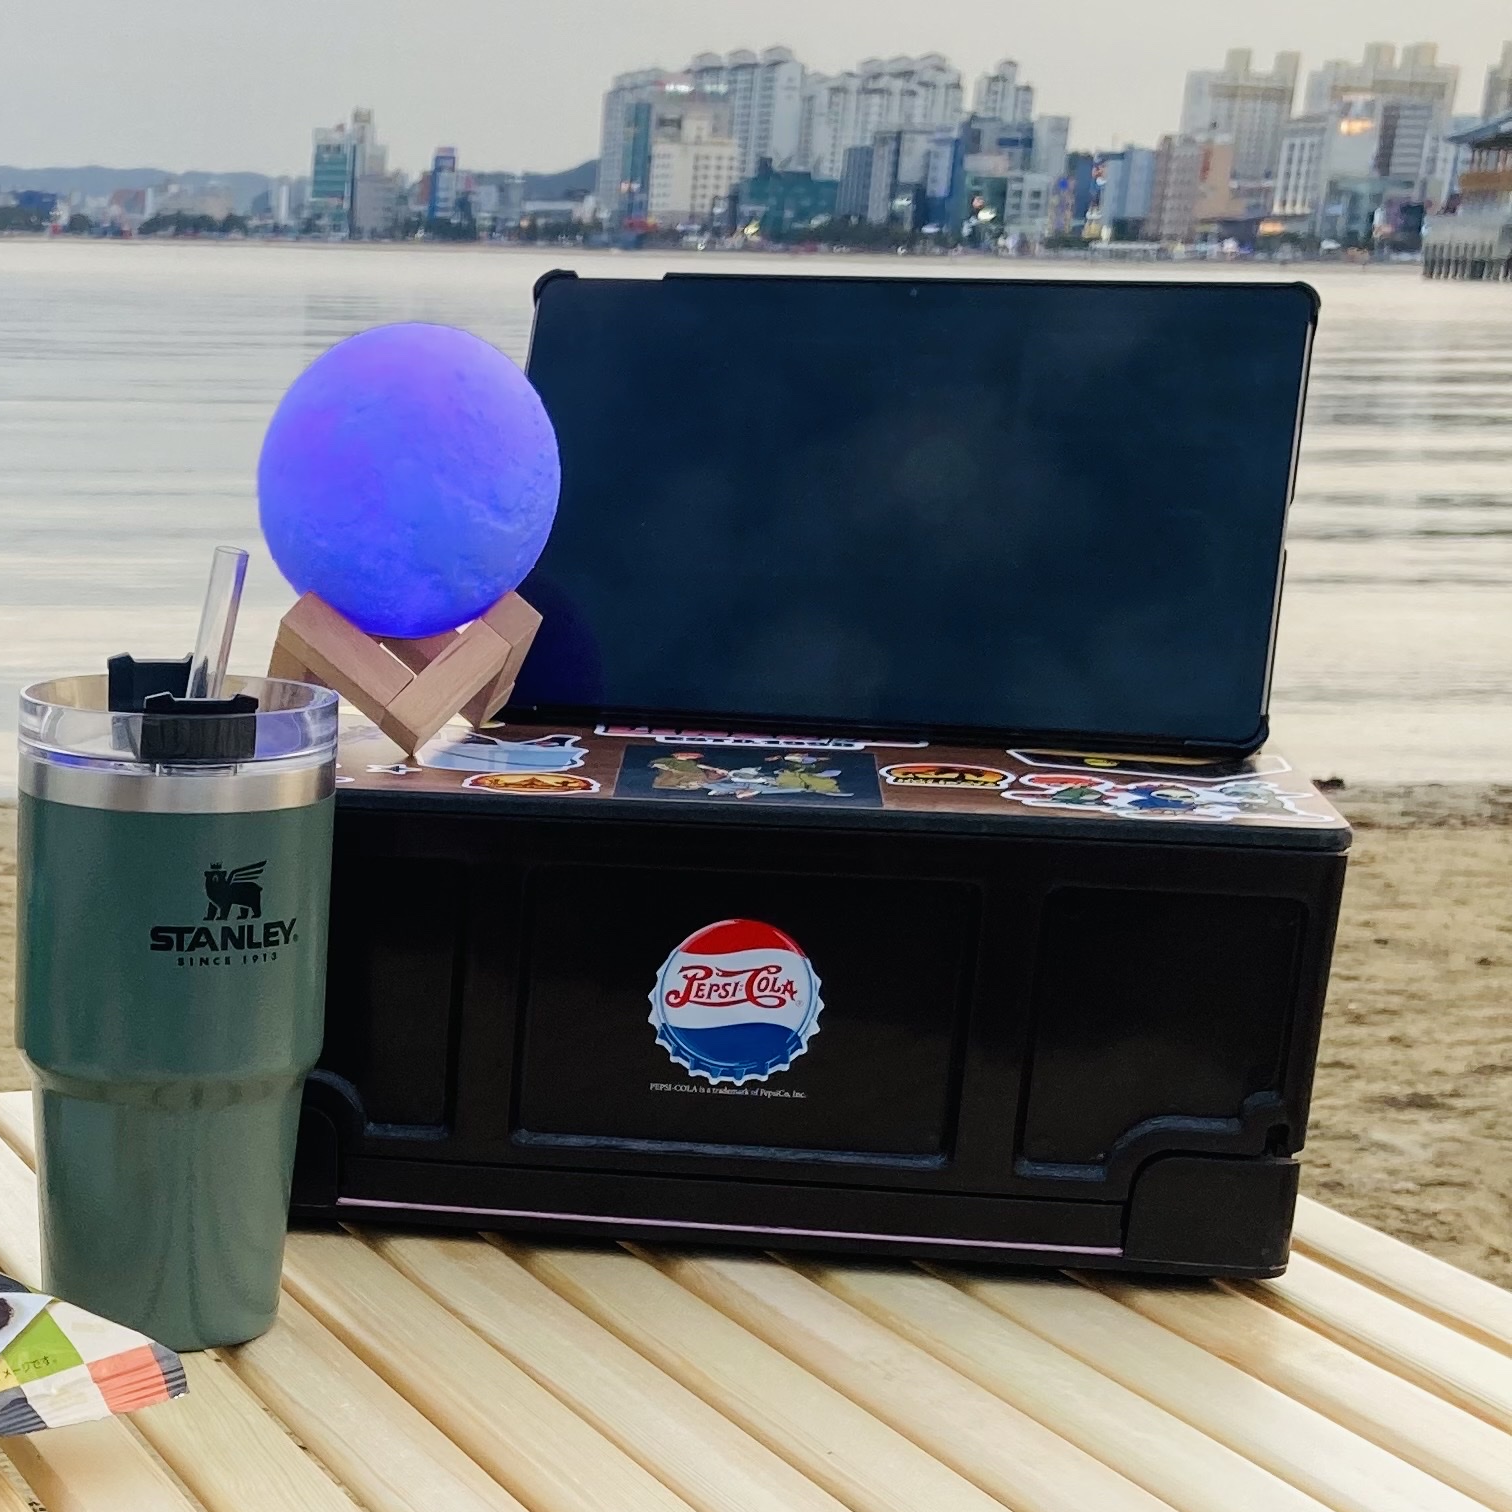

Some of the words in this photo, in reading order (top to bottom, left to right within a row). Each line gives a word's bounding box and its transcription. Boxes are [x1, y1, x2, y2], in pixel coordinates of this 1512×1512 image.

[150, 918, 296, 952] STANLEY
[177, 956, 231, 967] SINCE
[243, 952, 277, 964] 1913
[649, 1082, 697, 1093] PEPSI-COLA
[712, 1086, 749, 1095] trademark
